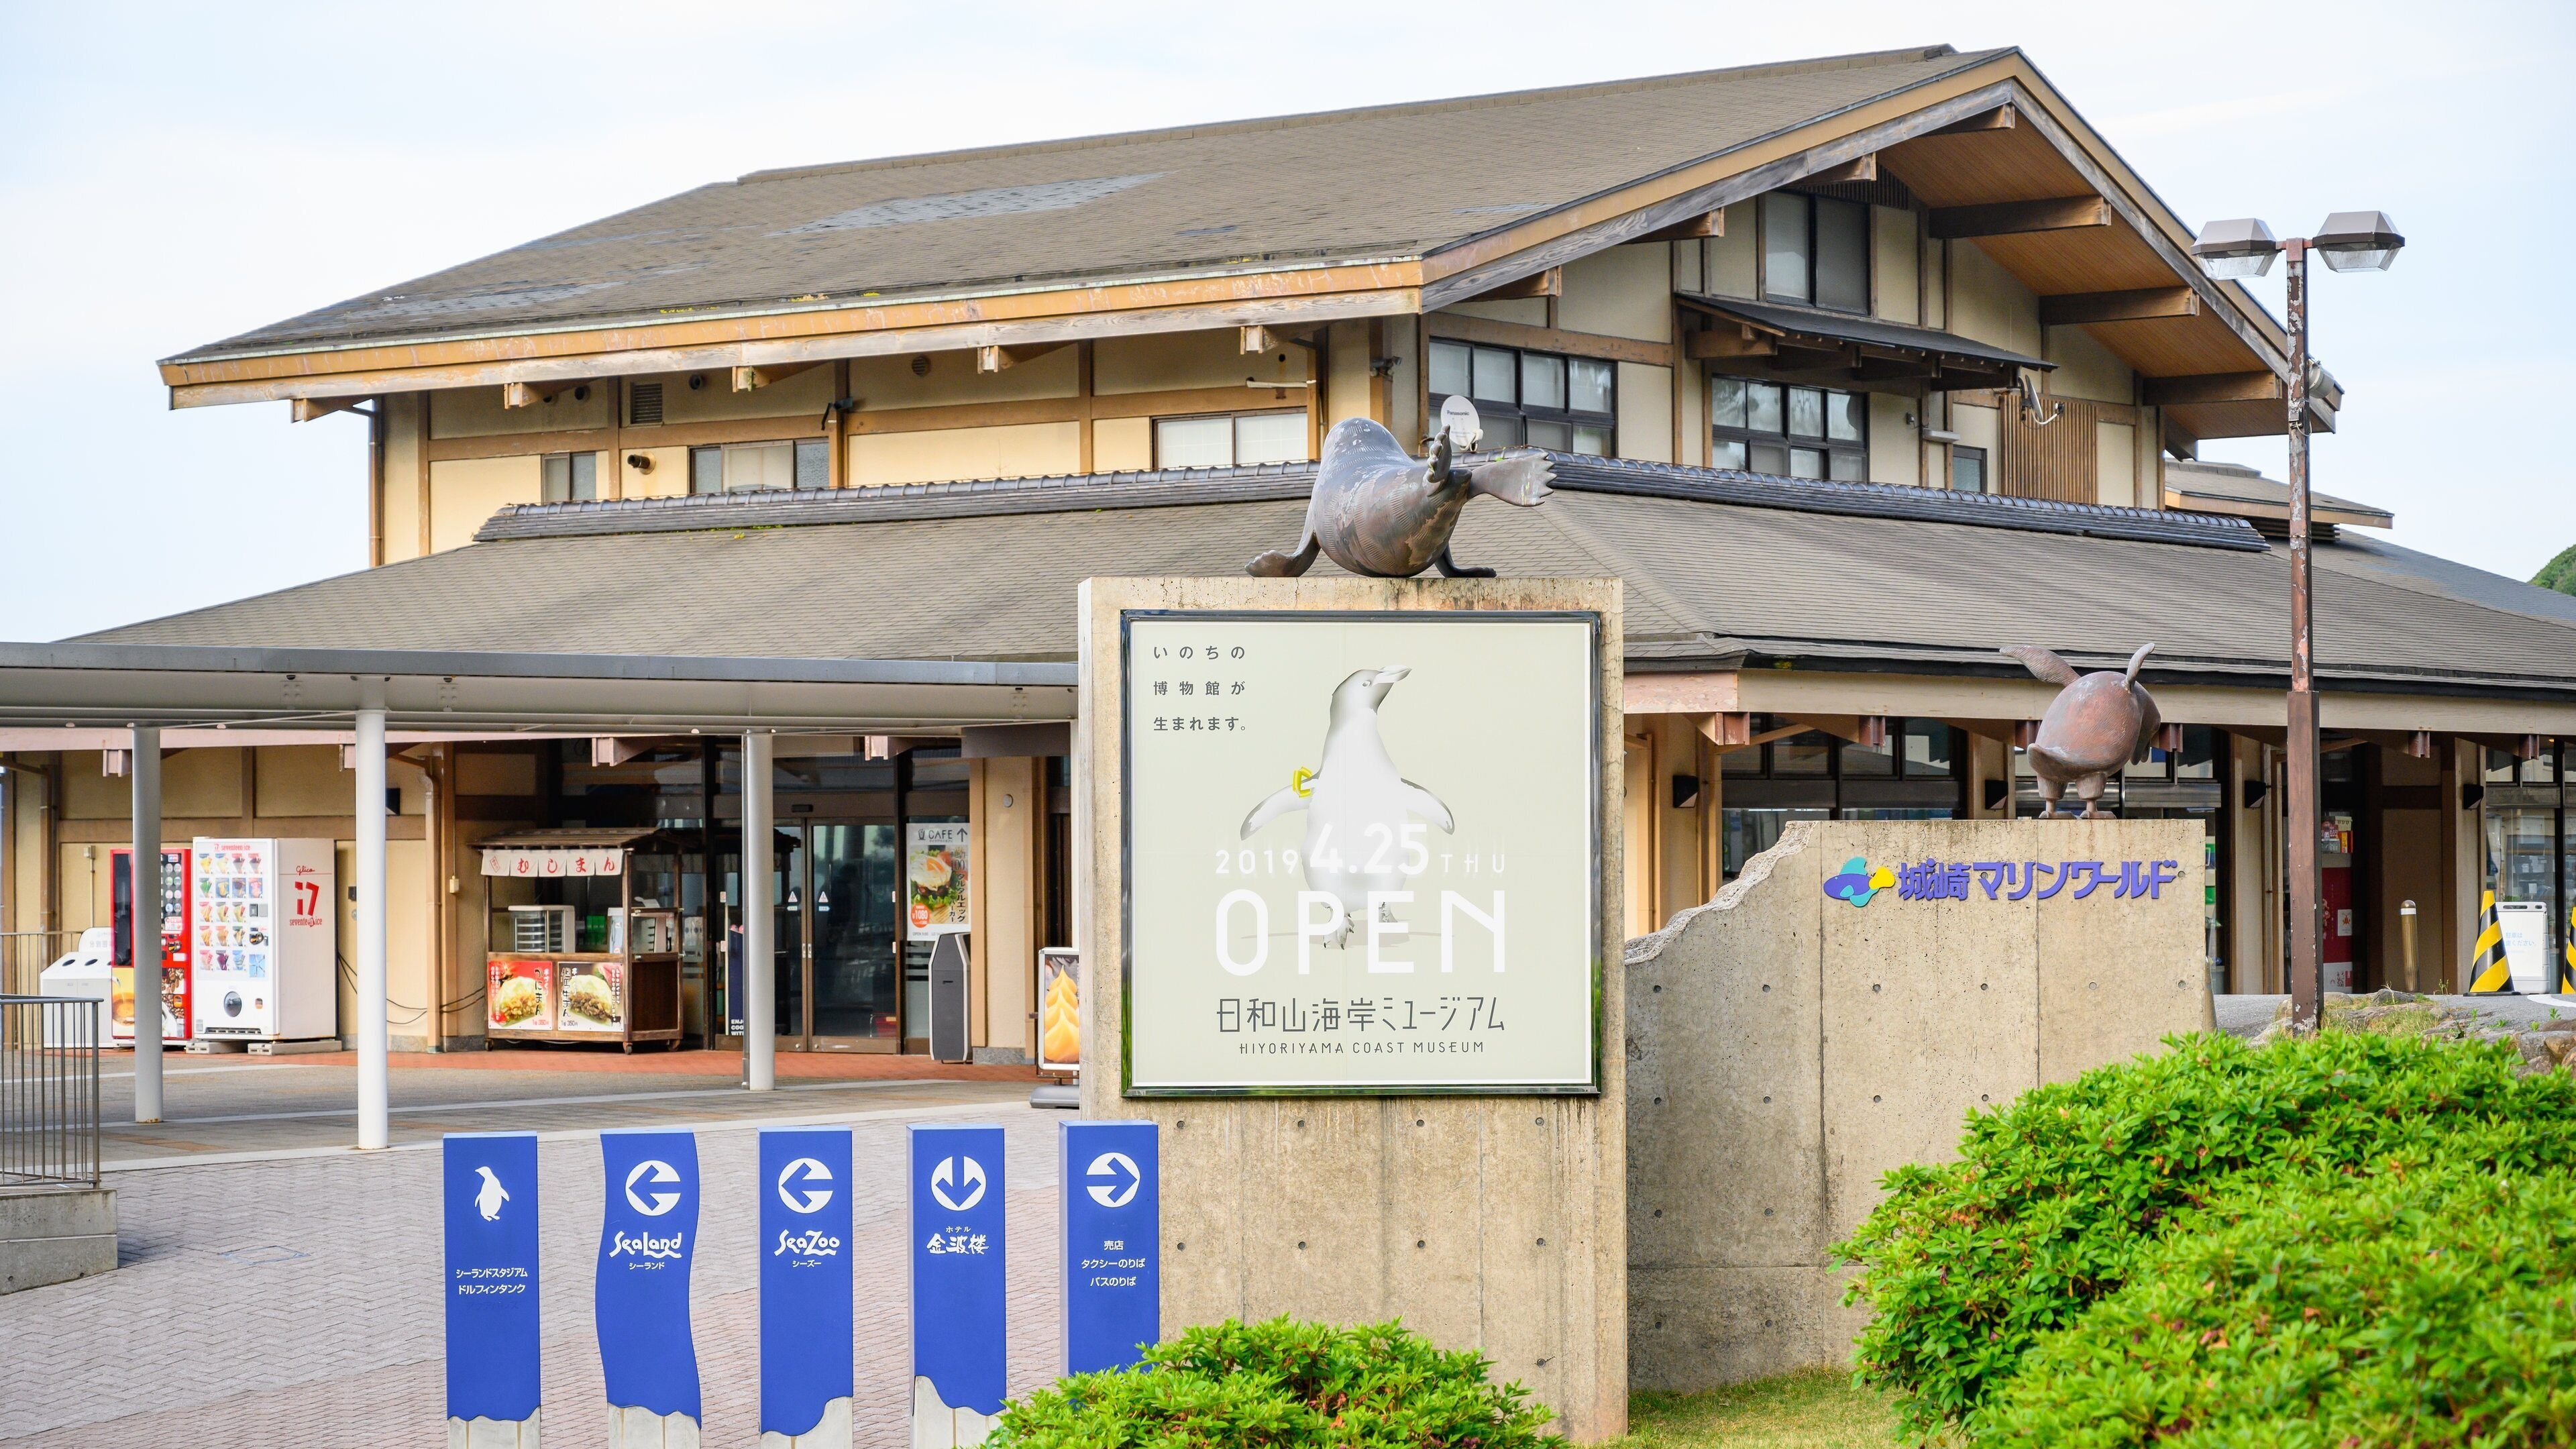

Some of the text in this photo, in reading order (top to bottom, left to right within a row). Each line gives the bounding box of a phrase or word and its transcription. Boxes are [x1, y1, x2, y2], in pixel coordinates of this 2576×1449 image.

[1153, 645, 1246, 660] いのちの
[1152, 680, 1246, 696] 博物館が
[1152, 716, 1246, 732] 生まれます。
[928, 830, 953, 839] CAFE
[1216, 822, 1505, 875] 2019 4.25 THU
[296, 865, 315, 875] Glico
[517, 857, 615, 873] むしまん
[1898, 857, 2178, 901] 城崎マリンワールド
[957, 873, 966, 922] タルタルエッグ
[1216, 889, 1506, 977] OPEN
[1216, 996, 1505, 1033] 日和山海岸ミュージアム
[1239, 1041, 1484, 1055] HIYORIYAMA COAST MUSEUM
[608, 1230, 682, 1259] SeaLand
[773, 1229, 841, 1256] SeaZoo
[1104, 1240, 1124, 1250] 売店
[629, 1261, 665, 1270] シーランド
[792, 1259, 822, 1268] シーズー
[1081, 1258, 1146, 1269] タクシーのりば
[455, 1267, 528, 1279] シーランドスタジアム
[458, 1283, 526, 1295] ドルフィンタンク
[1090, 1276, 1137, 1287] バスのりば
